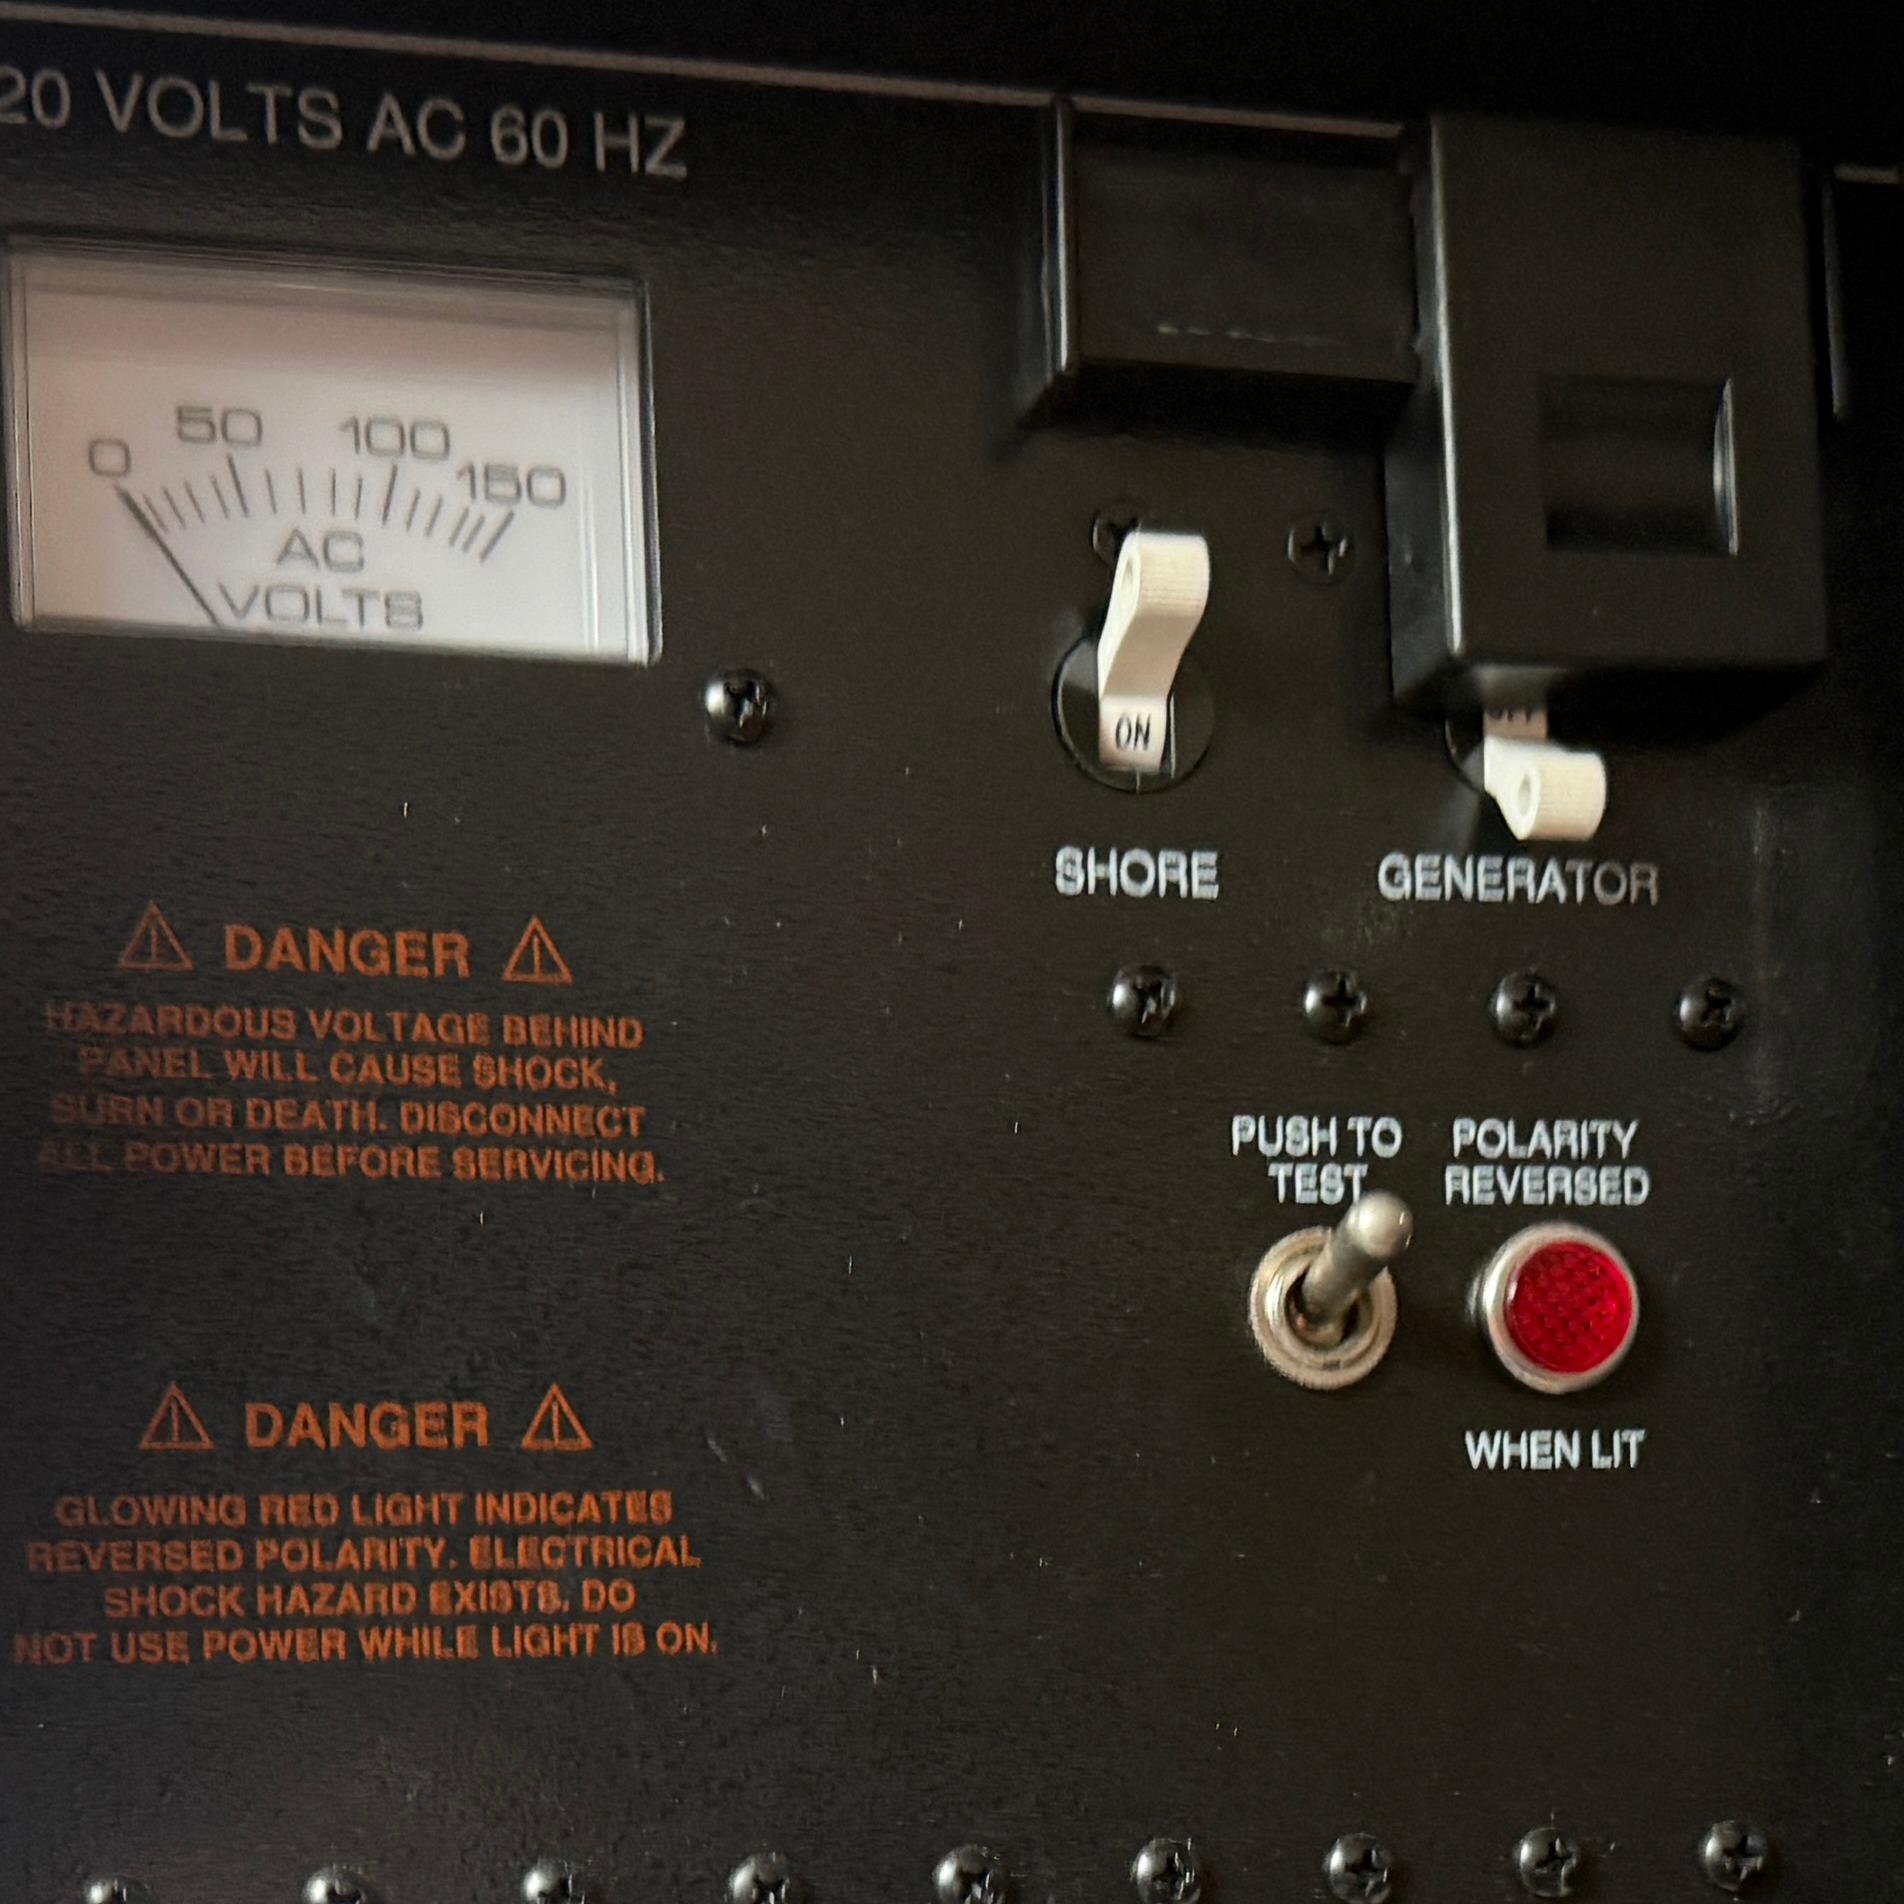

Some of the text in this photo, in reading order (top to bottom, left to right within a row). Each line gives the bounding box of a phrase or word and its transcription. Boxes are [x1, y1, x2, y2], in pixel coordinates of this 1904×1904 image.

[96, 70, 343, 150] VOLTS
[366, 94, 466, 159] AC
[491, 111, 569, 169] 60
[594, 113, 689, 180] HZ
[175, 406, 264, 449] 50
[339, 418, 451, 461] 100
[89, 439, 132, 479] 0
[456, 466, 566, 508] 150
[276, 530, 364, 572] AC
[218, 582, 423, 629] VOLTS
[1115, 712, 1151, 752] ON
[1055, 847, 1219, 901] SHORE
[1377, 854, 1659, 906] GENERATOR
[223, 925, 469, 979] DANGER
[45, 1004, 643, 1050] HAZARDOUS VOLTAGE BEHIND
[80, 1048, 616, 1096] PANEL WILL CAUSE SHOCK,
[175, 1098, 232, 1129] OR
[246, 1099, 387, 1133] DEATH.
[400, 1101, 645, 1138] DISCONNECT
[1232, 1115, 1402, 1158] PUSH TO
[1453, 1118, 1639, 1160] POLARITY
[124, 1143, 270, 1175] POWER
[283, 1145, 439, 1180] BEFORE
[452, 1147, 664, 1184] SERVICING.
[1268, 1163, 1367, 1205] TEST
[1445, 1165, 1650, 1207] REVERSED
[245, 1402, 488, 1452] DANGER
[1465, 1429, 1646, 1471] WHEN LIT
[55, 1489, 672, 1528] GLOWING RED LIGHT INDICATES
[27, 1540, 242, 1573] REVERSED
[470, 1534, 701, 1570] ELECTRICAL
[104, 1579, 635, 1618] SHOCK HAZARD EXISTS. DO
[14, 1632, 95, 1665] NOT
[111, 1631, 189, 1664] USE
[203, 1628, 346, 1662] POWER
[359, 1626, 478, 1659] WHILE
[492, 1623, 600, 1658] LIGHT
[612, 1622, 645, 1656] IS
